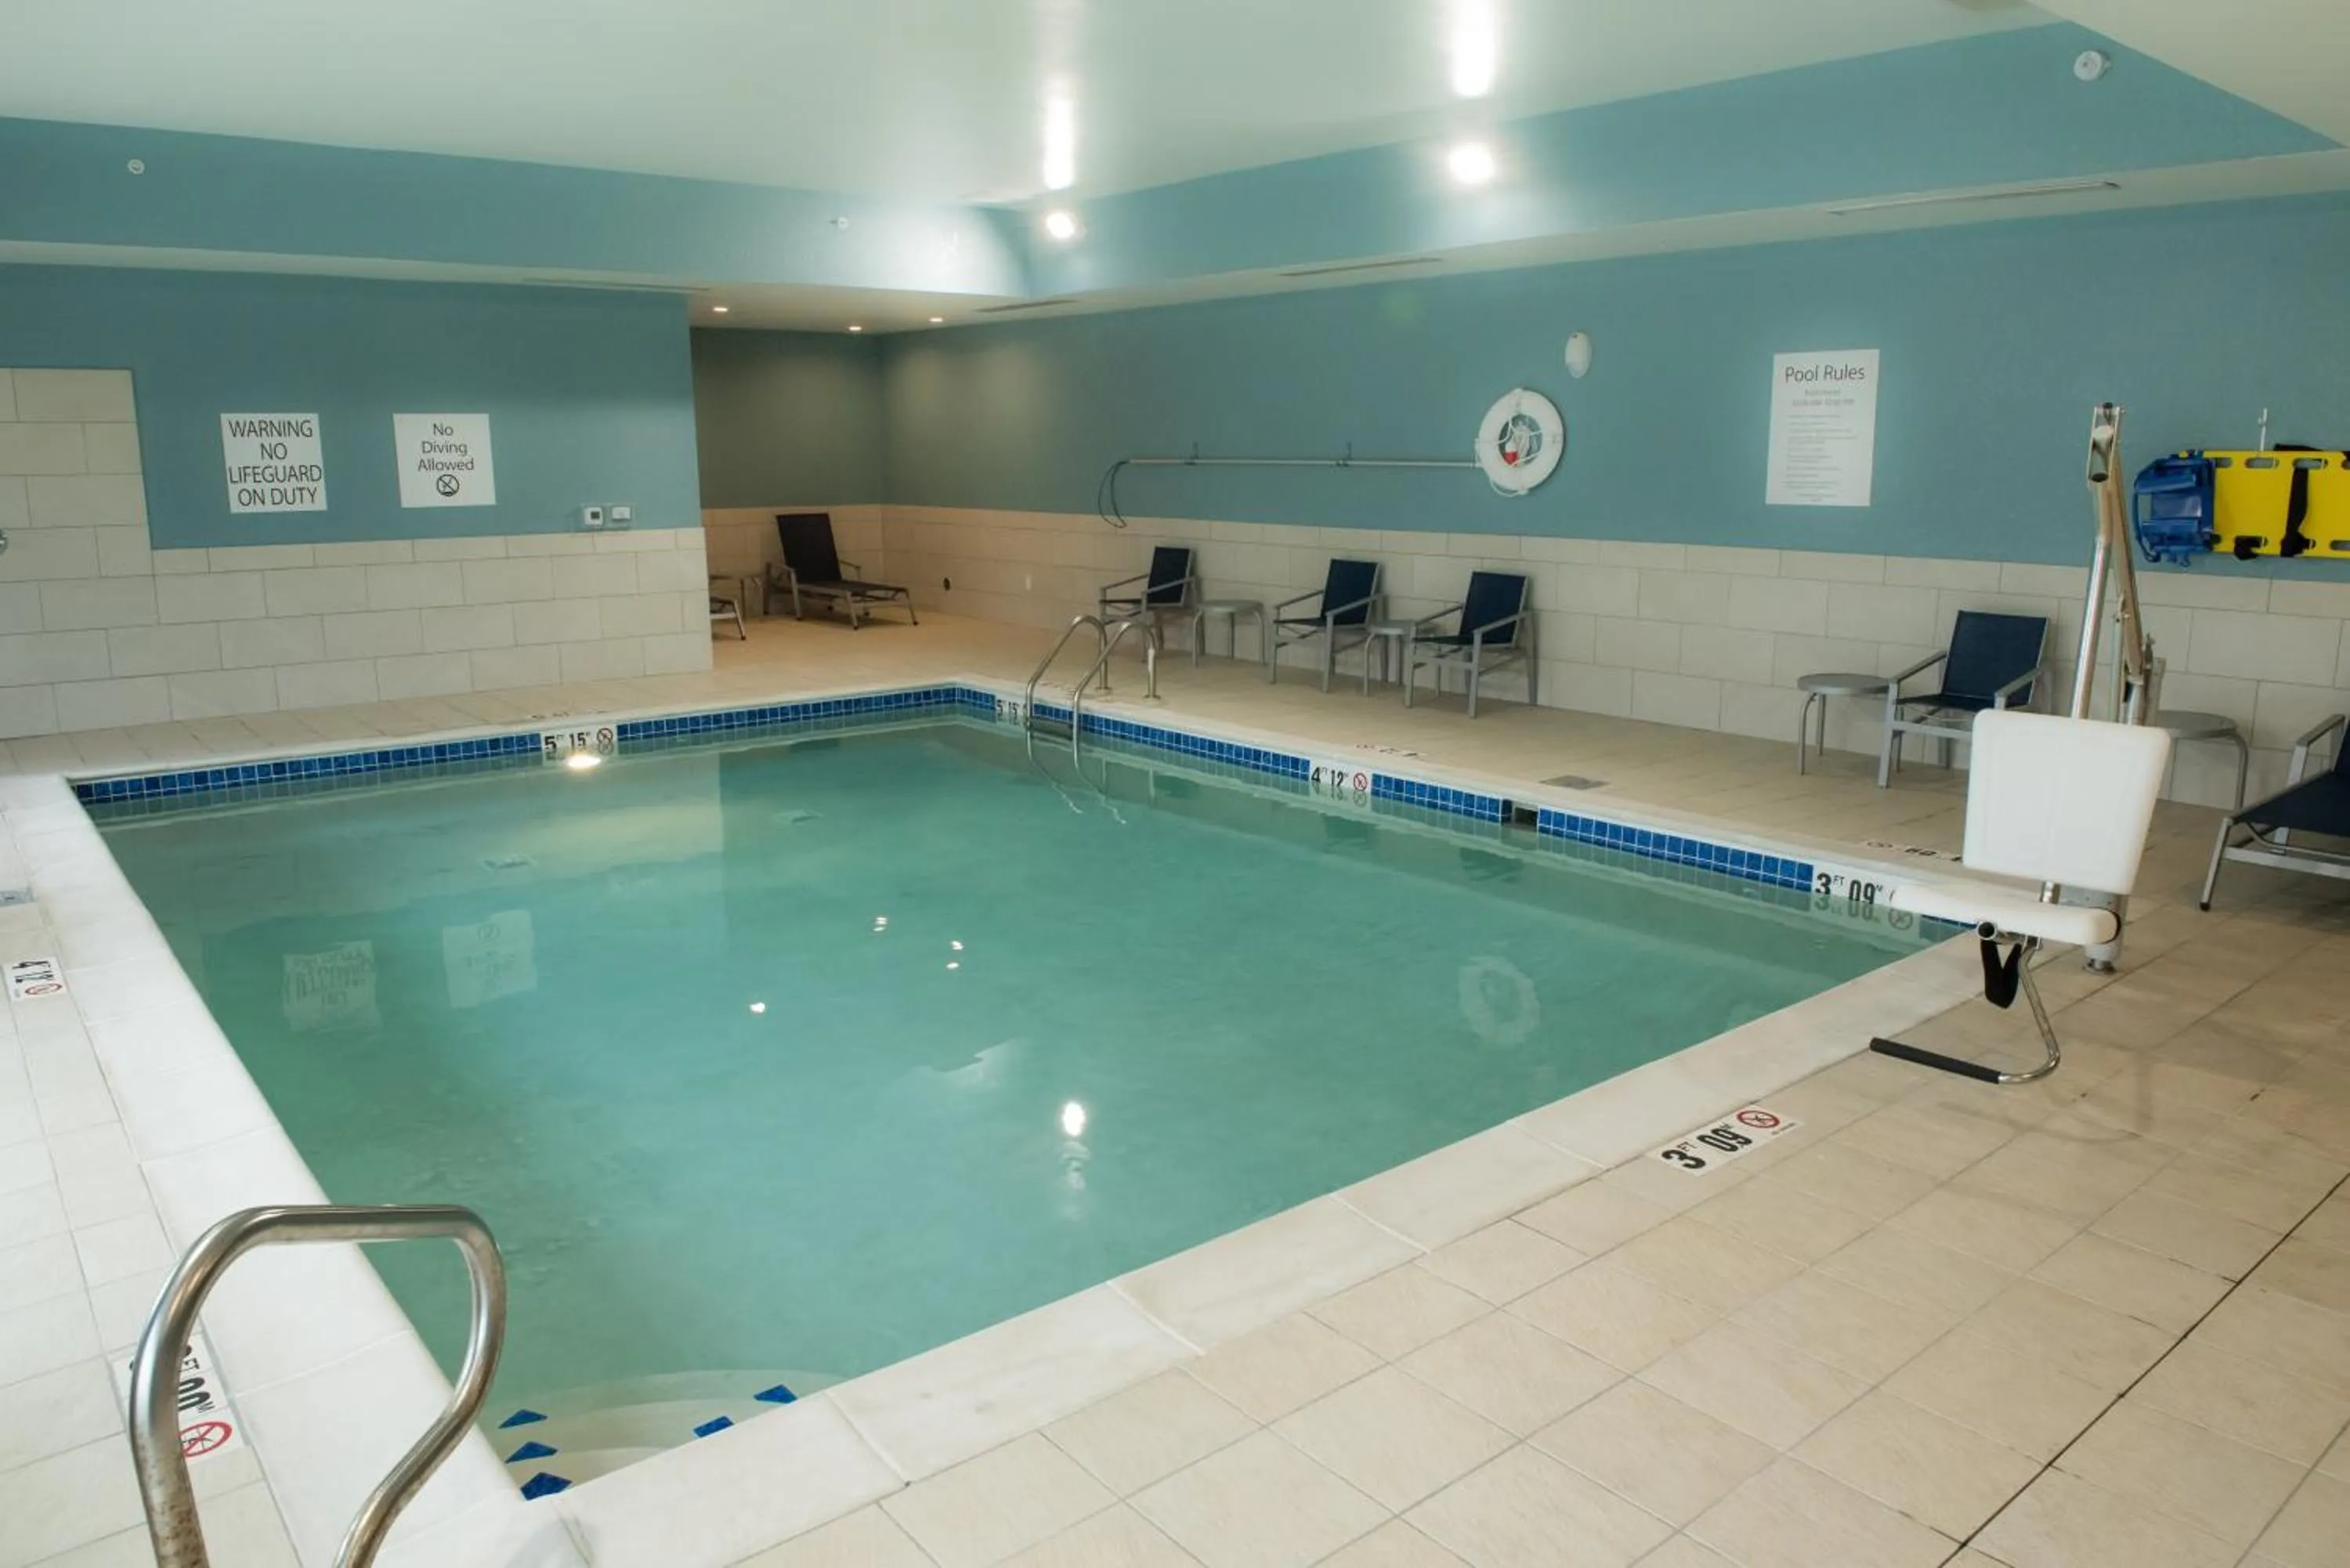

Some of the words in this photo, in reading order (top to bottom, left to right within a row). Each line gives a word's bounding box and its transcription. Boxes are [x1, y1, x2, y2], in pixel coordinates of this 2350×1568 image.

[1784, 365, 1819, 383] Pool
[1824, 363, 1865, 381] Rules
[228, 419, 313, 438] WARNING
[432, 423, 454, 436] No
[260, 443, 287, 461] NO
[421, 440, 468, 456] Diving
[418, 457, 474, 471] Allowed
[228, 464, 322, 483] LIFEGUARD
[237, 488, 266, 507] ON
[270, 486, 317, 505] DUTY
